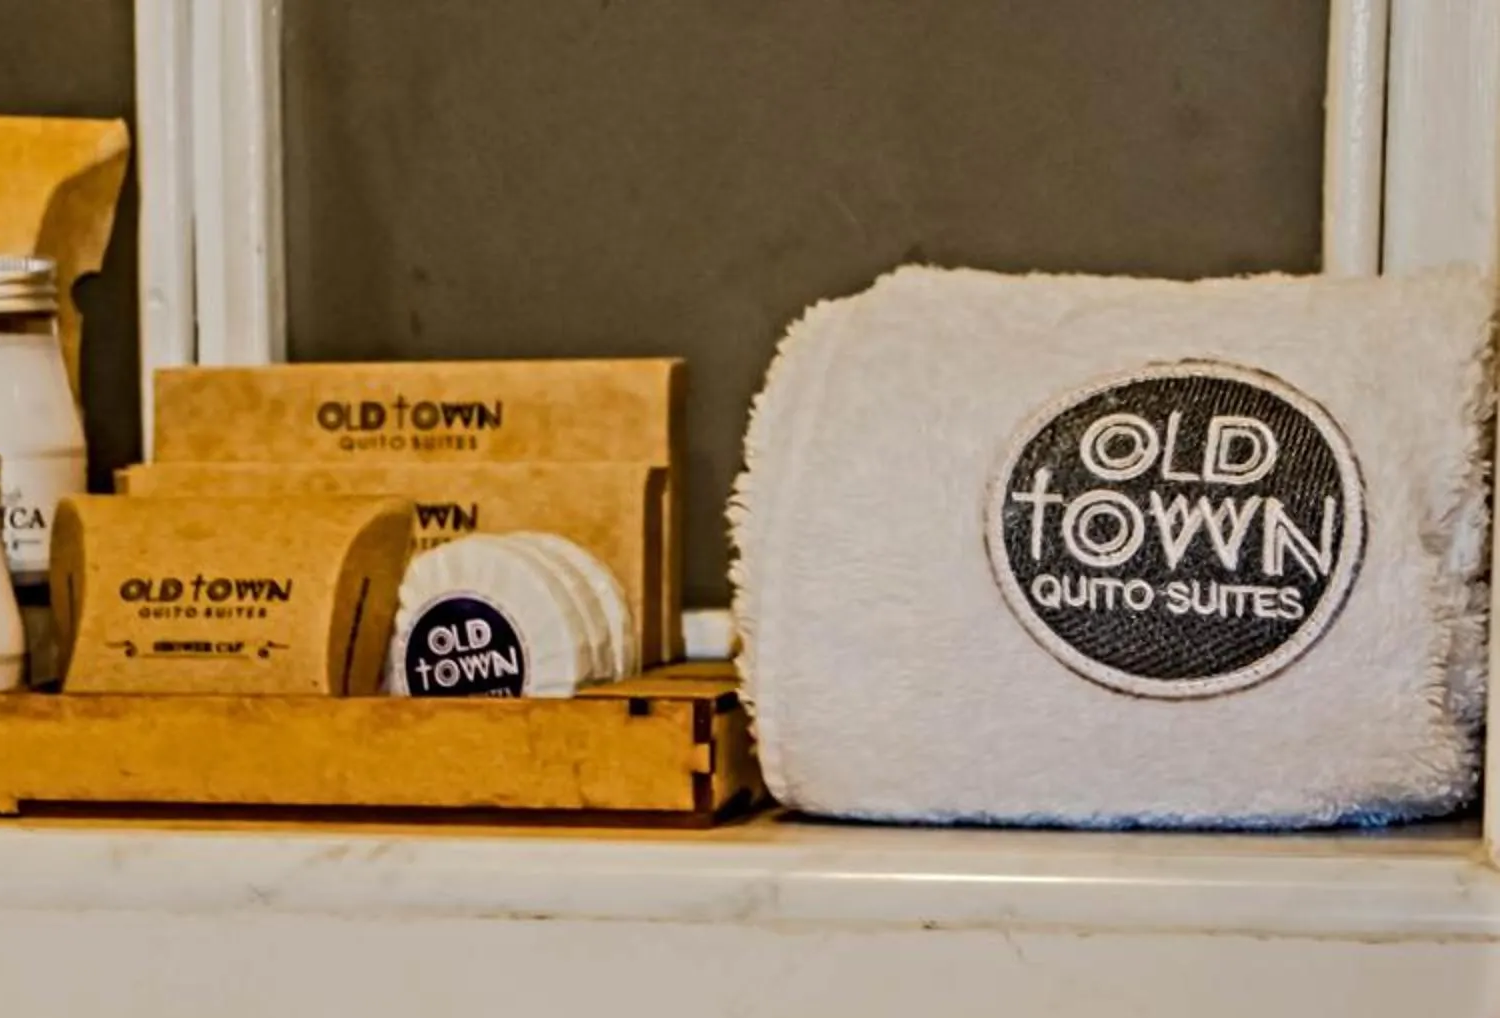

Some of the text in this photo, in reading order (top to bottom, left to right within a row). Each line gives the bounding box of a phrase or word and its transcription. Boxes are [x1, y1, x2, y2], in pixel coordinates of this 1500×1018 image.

[317, 401, 387, 432] OLD
[1079, 410, 1278, 485] OLD
[415, 502, 479, 532] WN
[119, 578, 184, 602] OLD
[1031, 573, 1305, 621] QUITO SUITES
[427, 618, 493, 655] OLD
